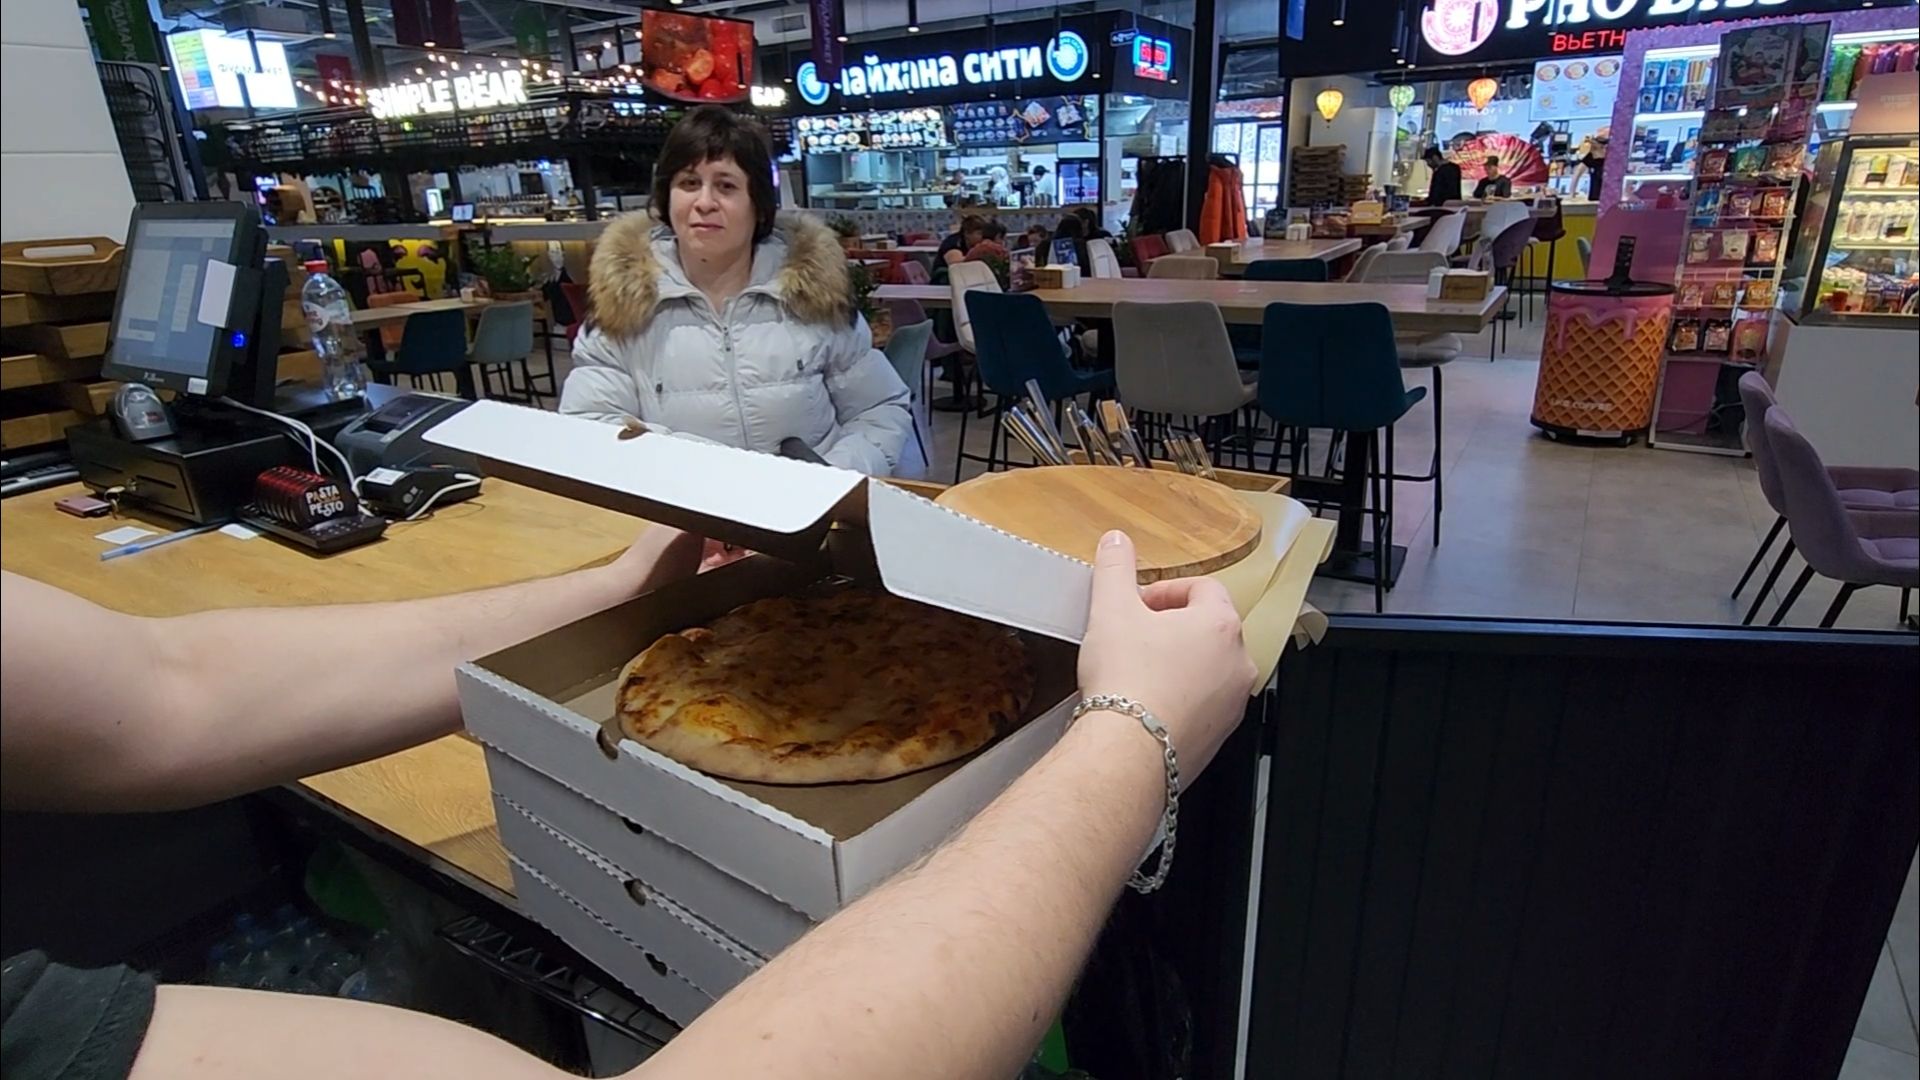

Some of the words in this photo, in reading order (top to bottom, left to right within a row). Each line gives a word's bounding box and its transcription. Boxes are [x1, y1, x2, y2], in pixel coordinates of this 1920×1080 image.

[1552, 30, 1626, 52] ВЬЕТН
[366, 80, 454, 119] SIMPLE
[453, 70, 527, 110] BEAR
[305, 484, 340, 504] PASTA
[310, 500, 344, 517] PESTO
